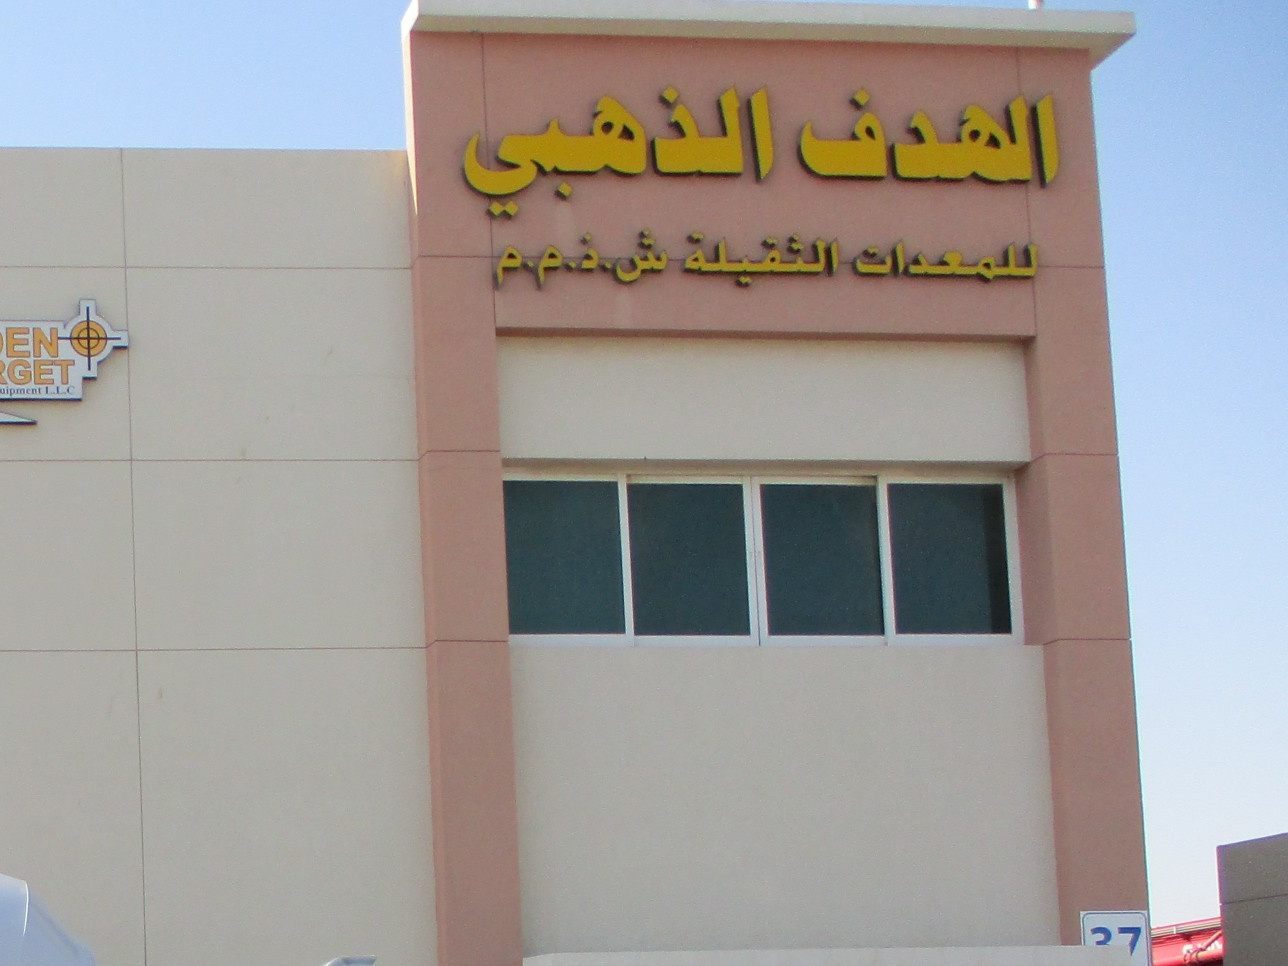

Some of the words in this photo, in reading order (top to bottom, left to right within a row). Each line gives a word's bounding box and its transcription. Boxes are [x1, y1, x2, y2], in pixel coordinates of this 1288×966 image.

[463, 85, 776, 217] الذهبي
[799, 89, 1061, 186] الهدف
[683, 232, 840, 286] الثقيلة
[854, 242, 1039, 281] للمعدات
